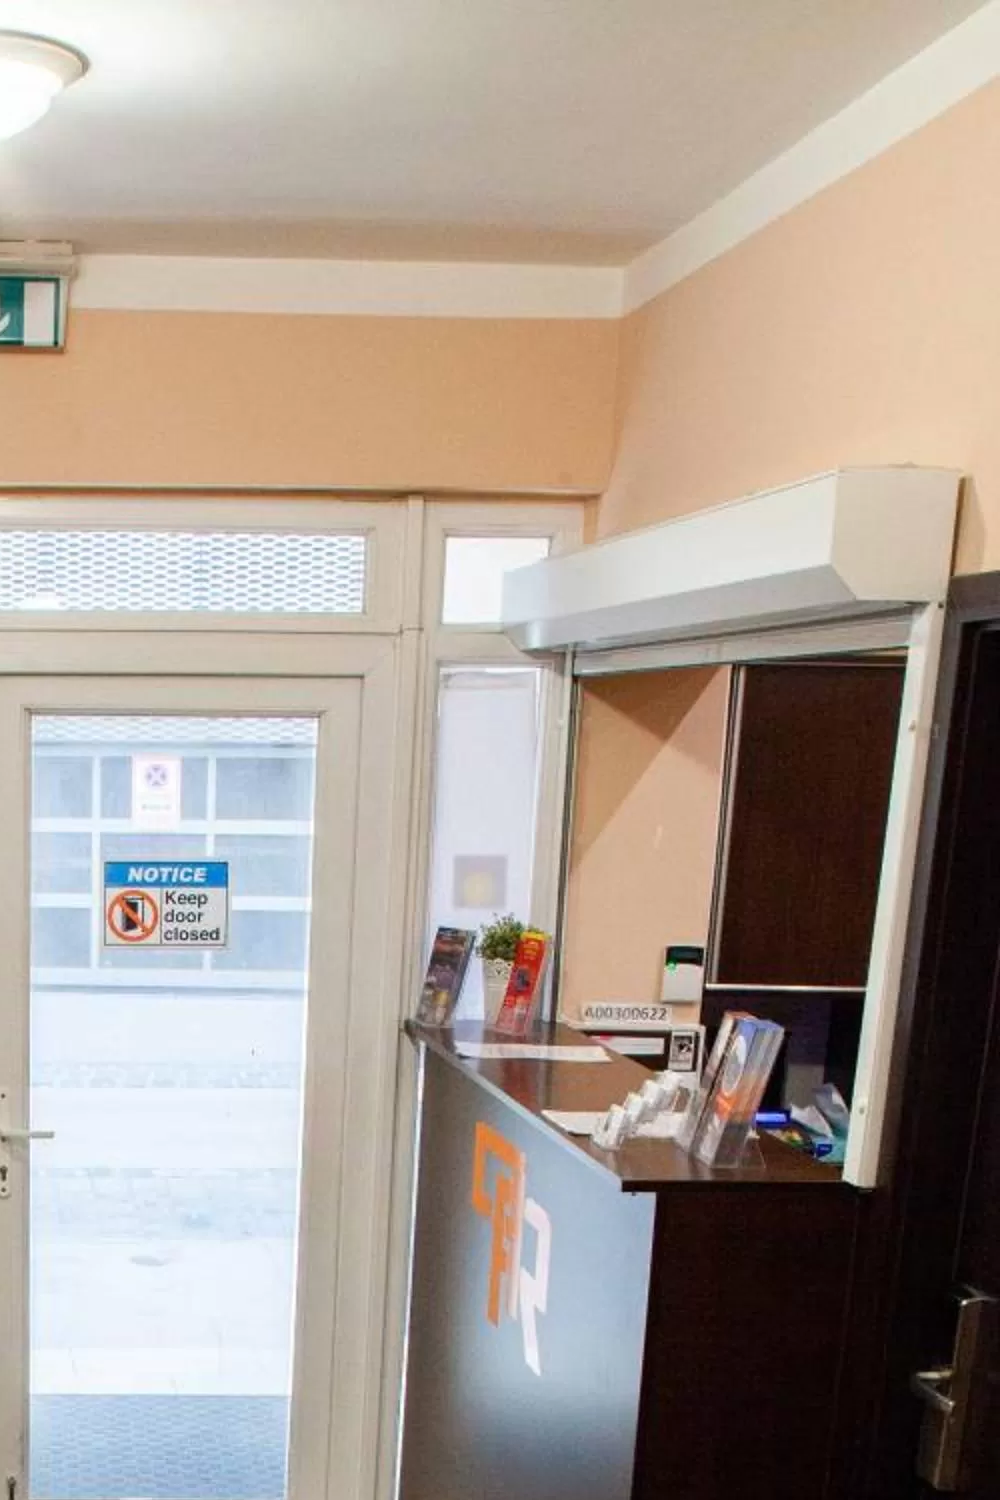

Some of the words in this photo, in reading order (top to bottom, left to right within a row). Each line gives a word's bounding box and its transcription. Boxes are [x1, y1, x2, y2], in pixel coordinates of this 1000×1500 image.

[127, 867, 208, 883] NOTICE
[164, 890, 208, 908] Keep
[164, 909, 204, 923] door
[163, 927, 220, 941] closed
